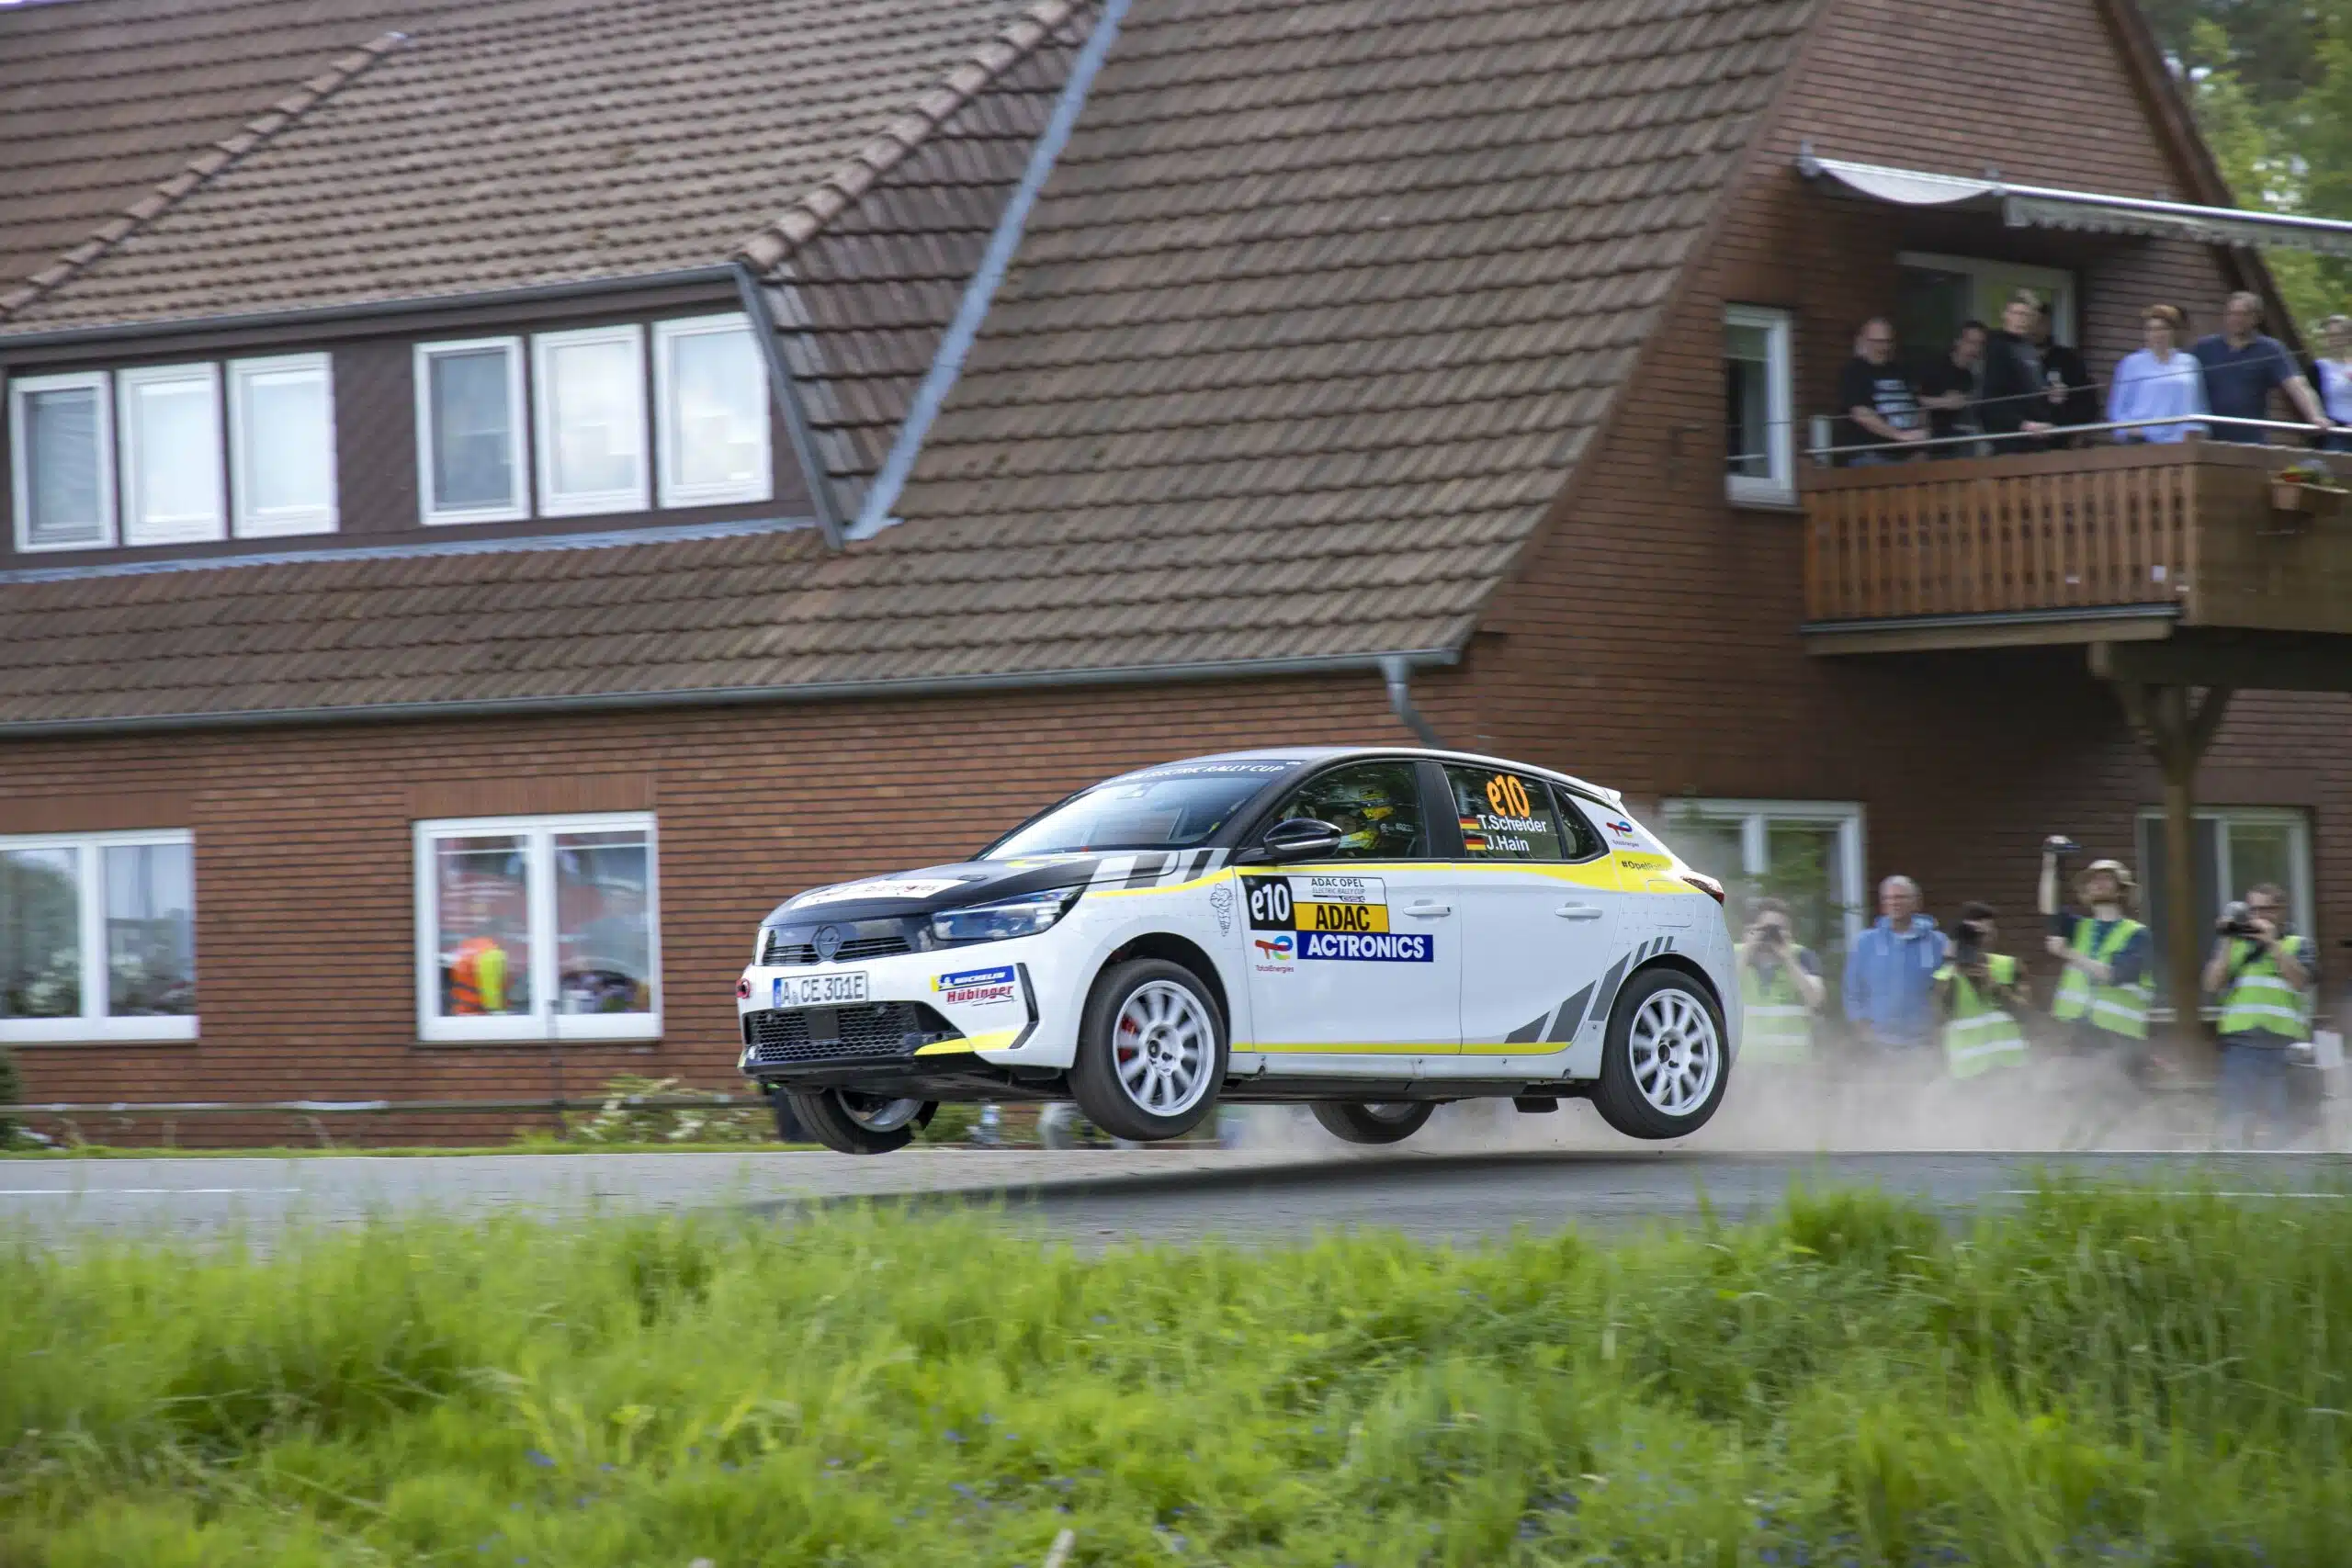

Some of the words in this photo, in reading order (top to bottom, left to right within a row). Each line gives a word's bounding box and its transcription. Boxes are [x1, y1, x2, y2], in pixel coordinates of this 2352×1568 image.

[1203, 764, 1250, 773] RALLY
[1248, 764, 1285, 773] CUP
[1486, 774, 1531, 818] e10
[1476, 814, 1547, 832] T.Scheider
[1487, 835, 1530, 852] J.Hain
[1311, 877, 1339, 887] ADAC
[1340, 878, 1364, 887] OPEL
[1250, 883, 1291, 922] e10
[1315, 904, 1371, 931] ADAC
[1306, 933, 1425, 959] ACTRONICS
[946, 985, 1014, 1002] Hübinger
